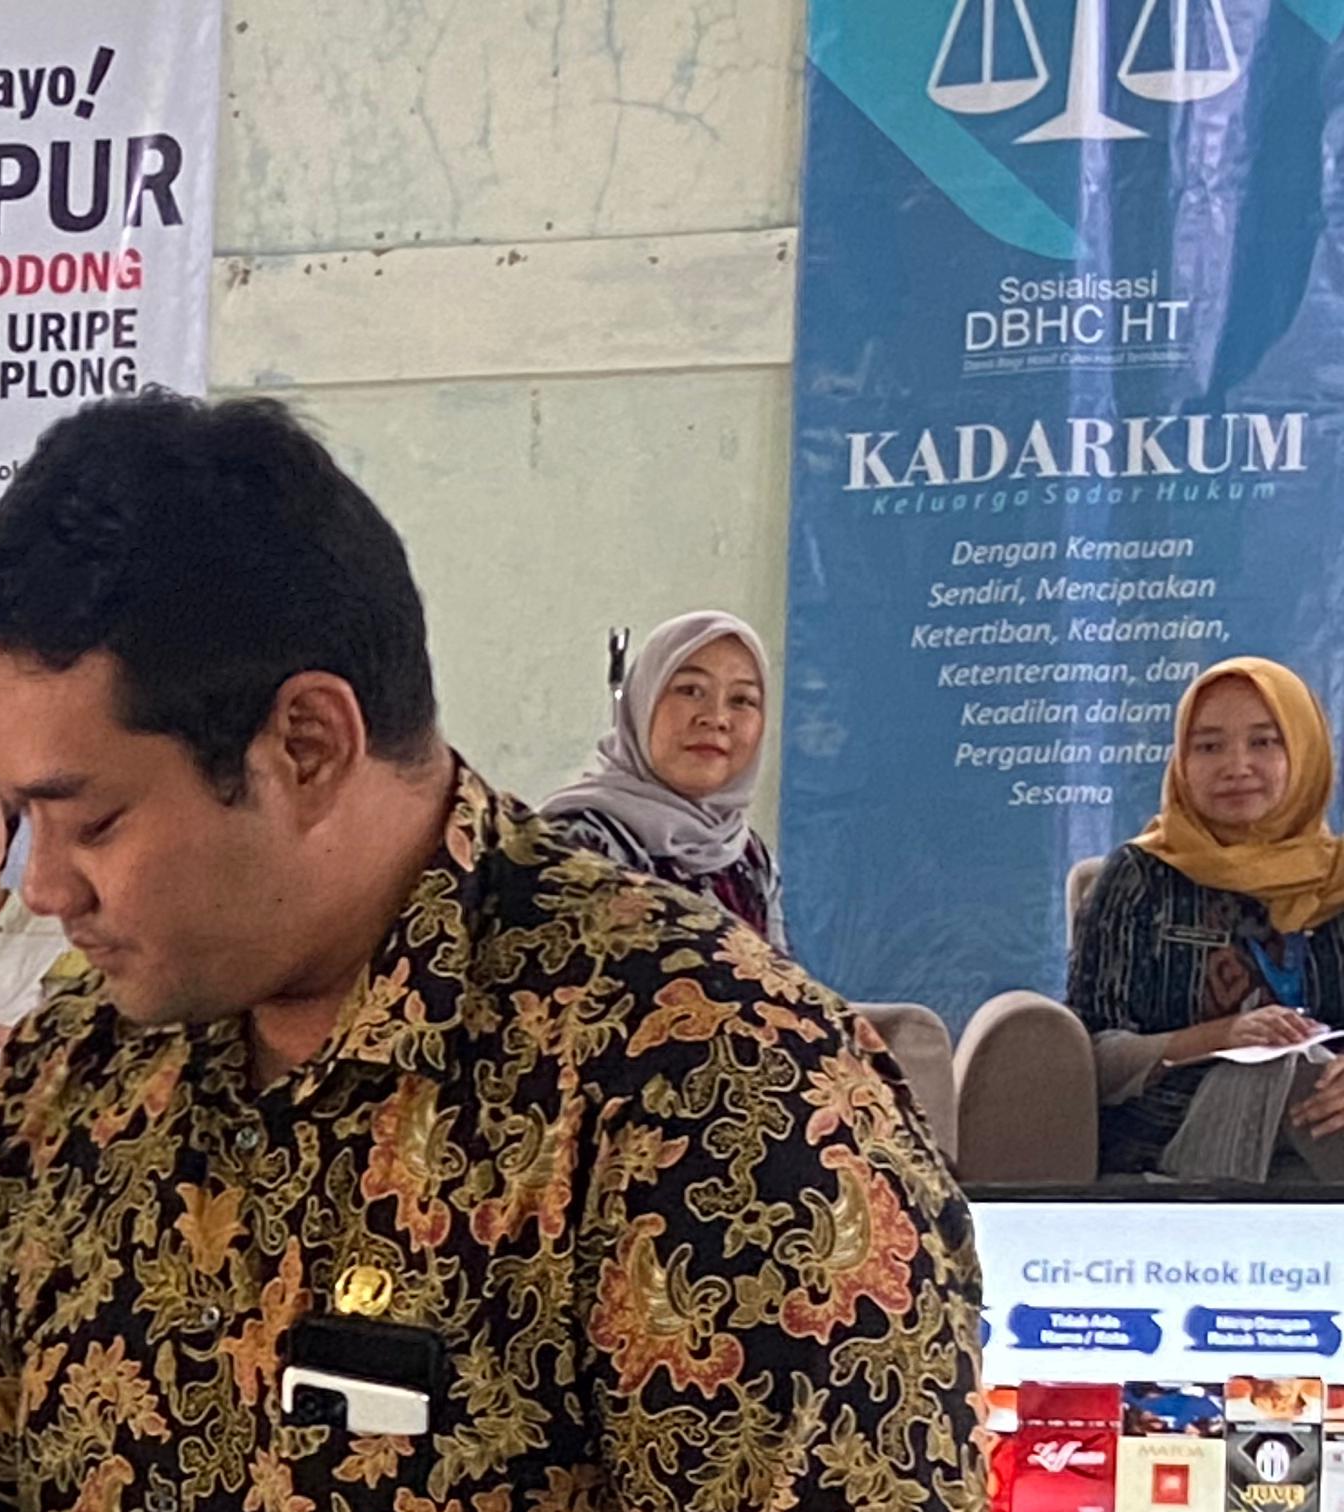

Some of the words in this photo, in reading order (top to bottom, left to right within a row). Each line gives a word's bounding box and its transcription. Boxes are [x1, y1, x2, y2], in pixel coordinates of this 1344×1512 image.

[999, 269, 1158, 304] Sosialisasi
[8, 308, 138, 353] URIPE
[966, 304, 1104, 350] DBHC
[1121, 301, 1189, 343] HT
[0, 357, 137, 399] PLONG
[843, 413, 1308, 491] KADARKUM
[1155, 480, 1277, 502] Hukum
[952, 538, 1057, 567] Dengan
[1065, 535, 1194, 562] Kemauan
[928, 578, 1026, 607] Sendiri,
[1035, 574, 1215, 604] Menciptakan
[911, 618, 1059, 648] Ketertiban,
[1068, 615, 1230, 643] Kedamaian,
[938, 660, 1136, 687] Ketenteraman,
[1146, 656, 1199, 682] dan
[961, 699, 1078, 726] Keadilan
[1085, 699, 1170, 723] dalam
[954, 739, 1090, 771] Pergaulan
[1009, 781, 1112, 805] Sesama
[1022, 1258, 1134, 1285] Ciri-Ciri
[1145, 1259, 1238, 1286] Rokok
[1248, 1260, 1331, 1291] Ilegal
